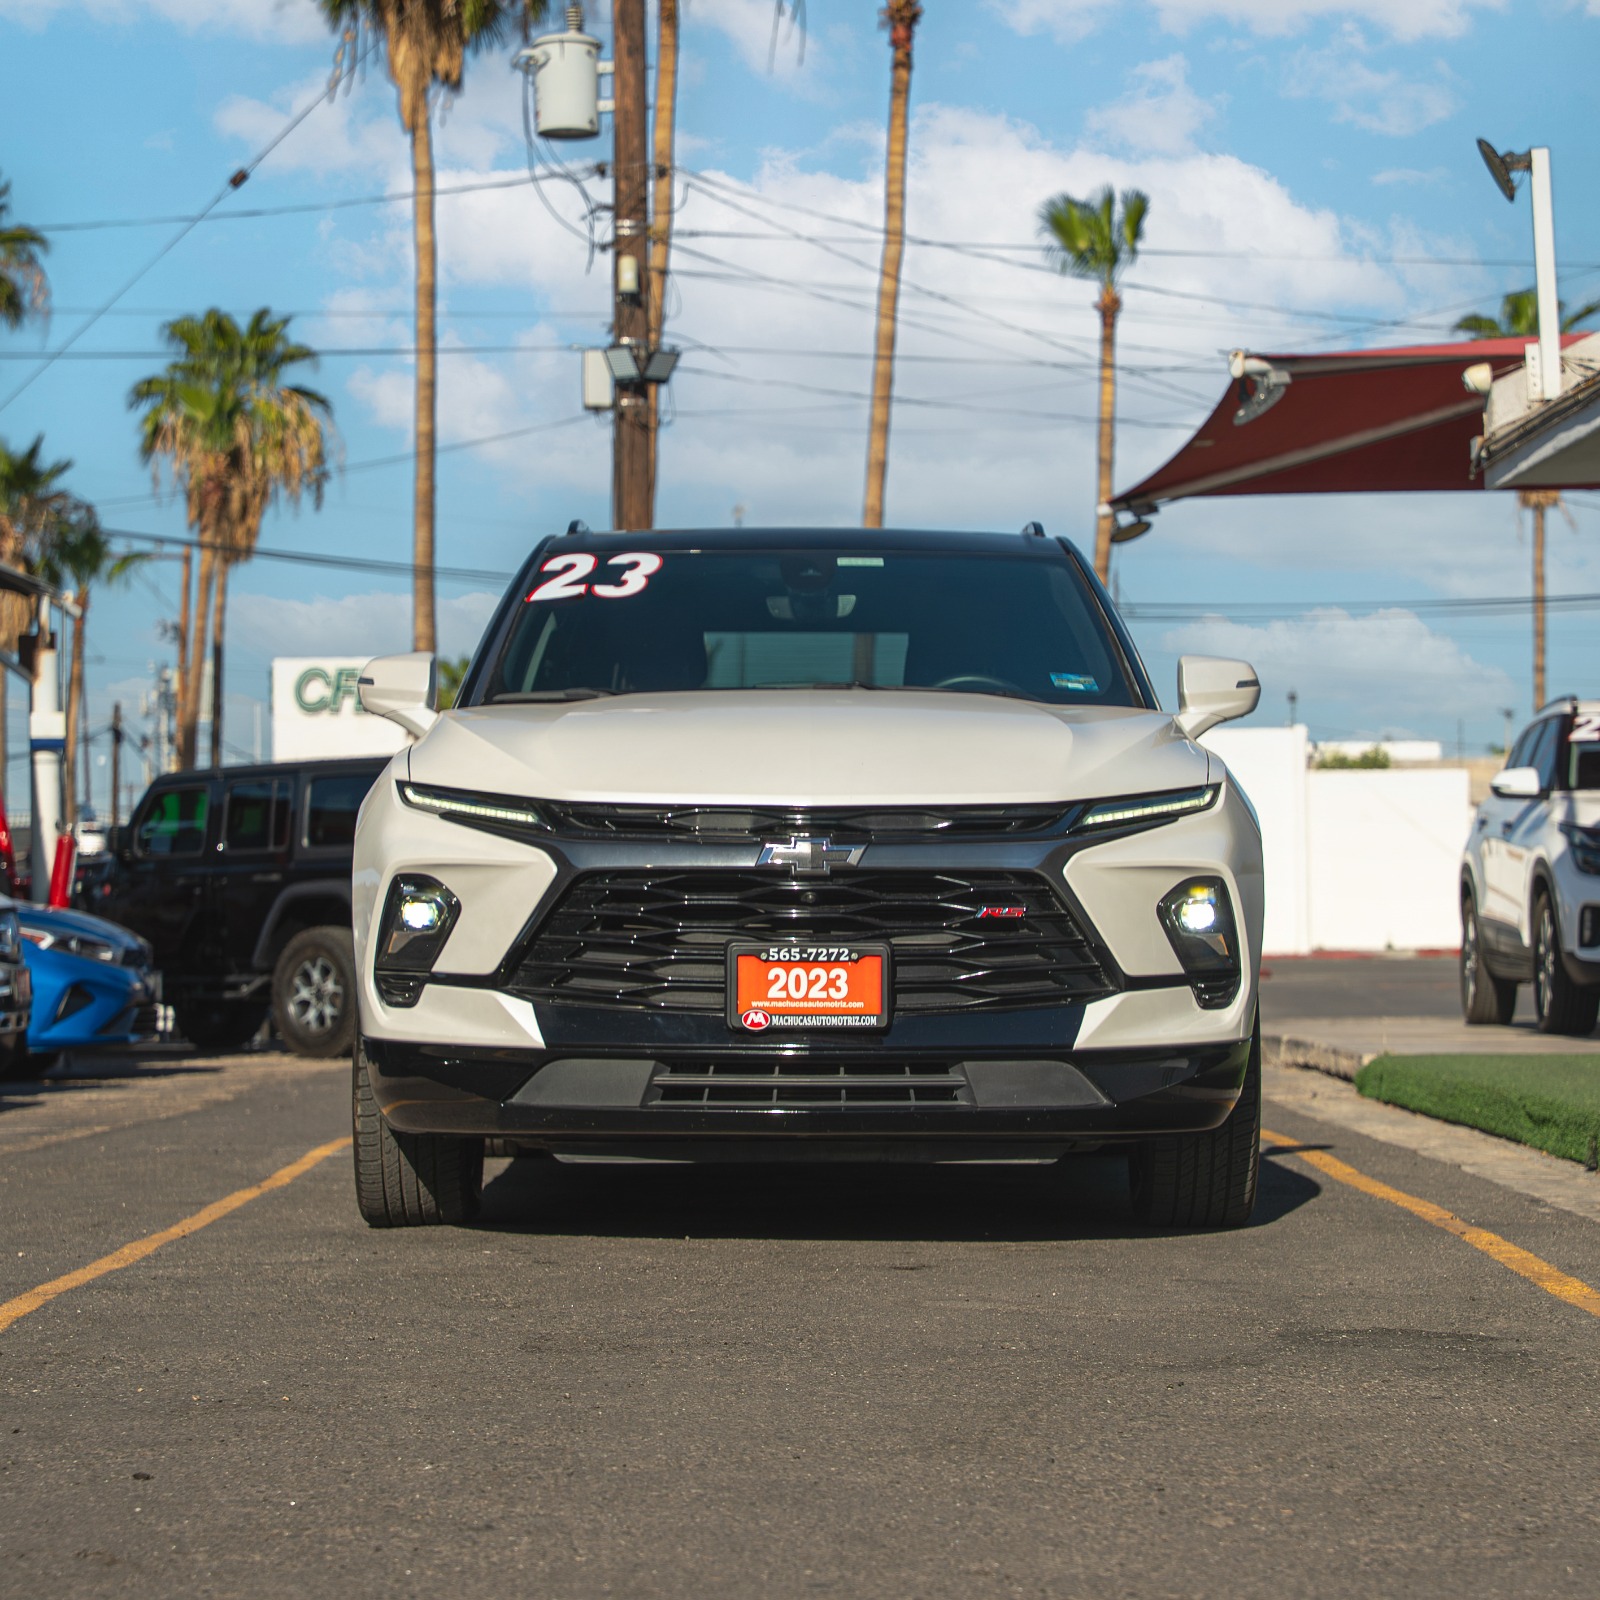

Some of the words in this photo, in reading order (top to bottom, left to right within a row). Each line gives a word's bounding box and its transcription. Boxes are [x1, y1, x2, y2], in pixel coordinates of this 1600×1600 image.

[525, 552, 663, 602] 23
[295, 667, 368, 714] CF
[768, 947, 849, 962] 565-7272
[767, 967, 849, 1000] 2023
[751, 1000, 864, 1009] www.machucasautomotriz.com
[771, 1015, 877, 1026] MACHUCASAUTOMOTRIZ.COM
